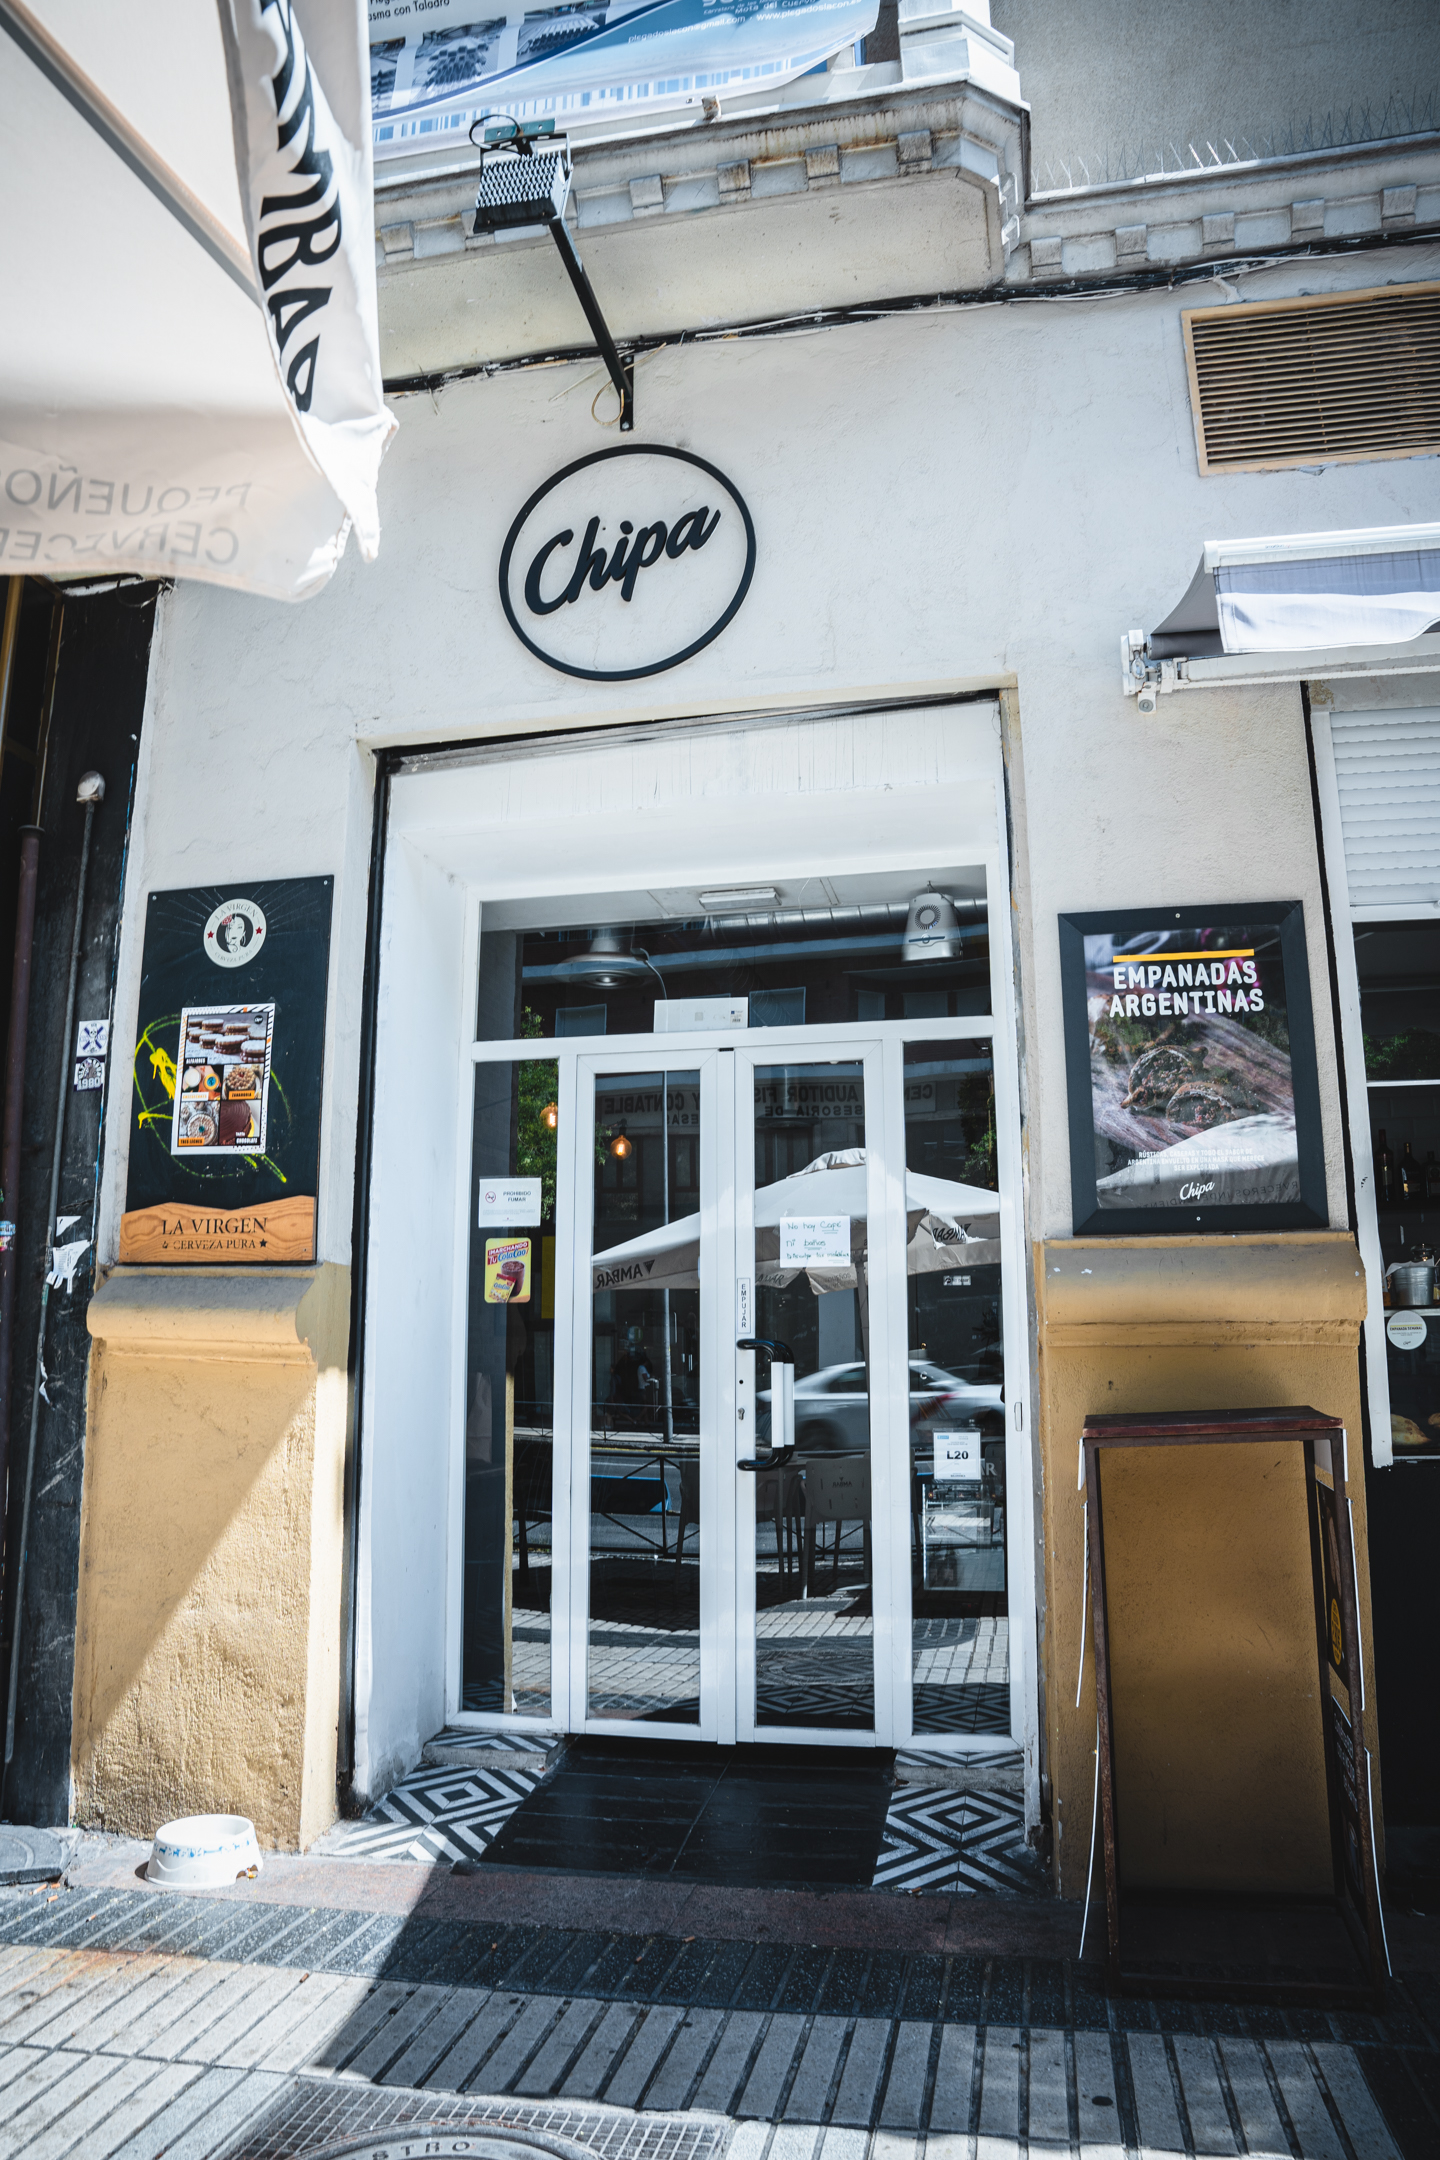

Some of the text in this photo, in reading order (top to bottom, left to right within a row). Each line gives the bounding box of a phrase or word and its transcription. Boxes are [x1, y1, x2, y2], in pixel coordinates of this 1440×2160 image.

[394, 5, 411, 17] con
[413, 0, 450, 13] Taladro
[735, 4, 759, 15] Mota
[763, 1, 778, 10] del
[524, 505, 721, 615] Chipa
[214, 902, 258, 921] LA VIRGEN
[1113, 960, 1257, 990] EMPANADAS
[1109, 988, 1265, 1018] ARGENTINAS
[77, 1077, 101, 1092] 1980
[1241, 1154, 1265, 1162] MERECE
[1179, 1181, 1215, 1200] Chipa
[161, 1216, 268, 1236] LA VIRGEN
[786, 1222, 799, 1230] No
[802, 1222, 816, 1232] hay
[173, 1238, 257, 1251] CERVEZA PURA
[785, 1238, 796, 1247] ni
[946, 1450, 969, 1460] L20
